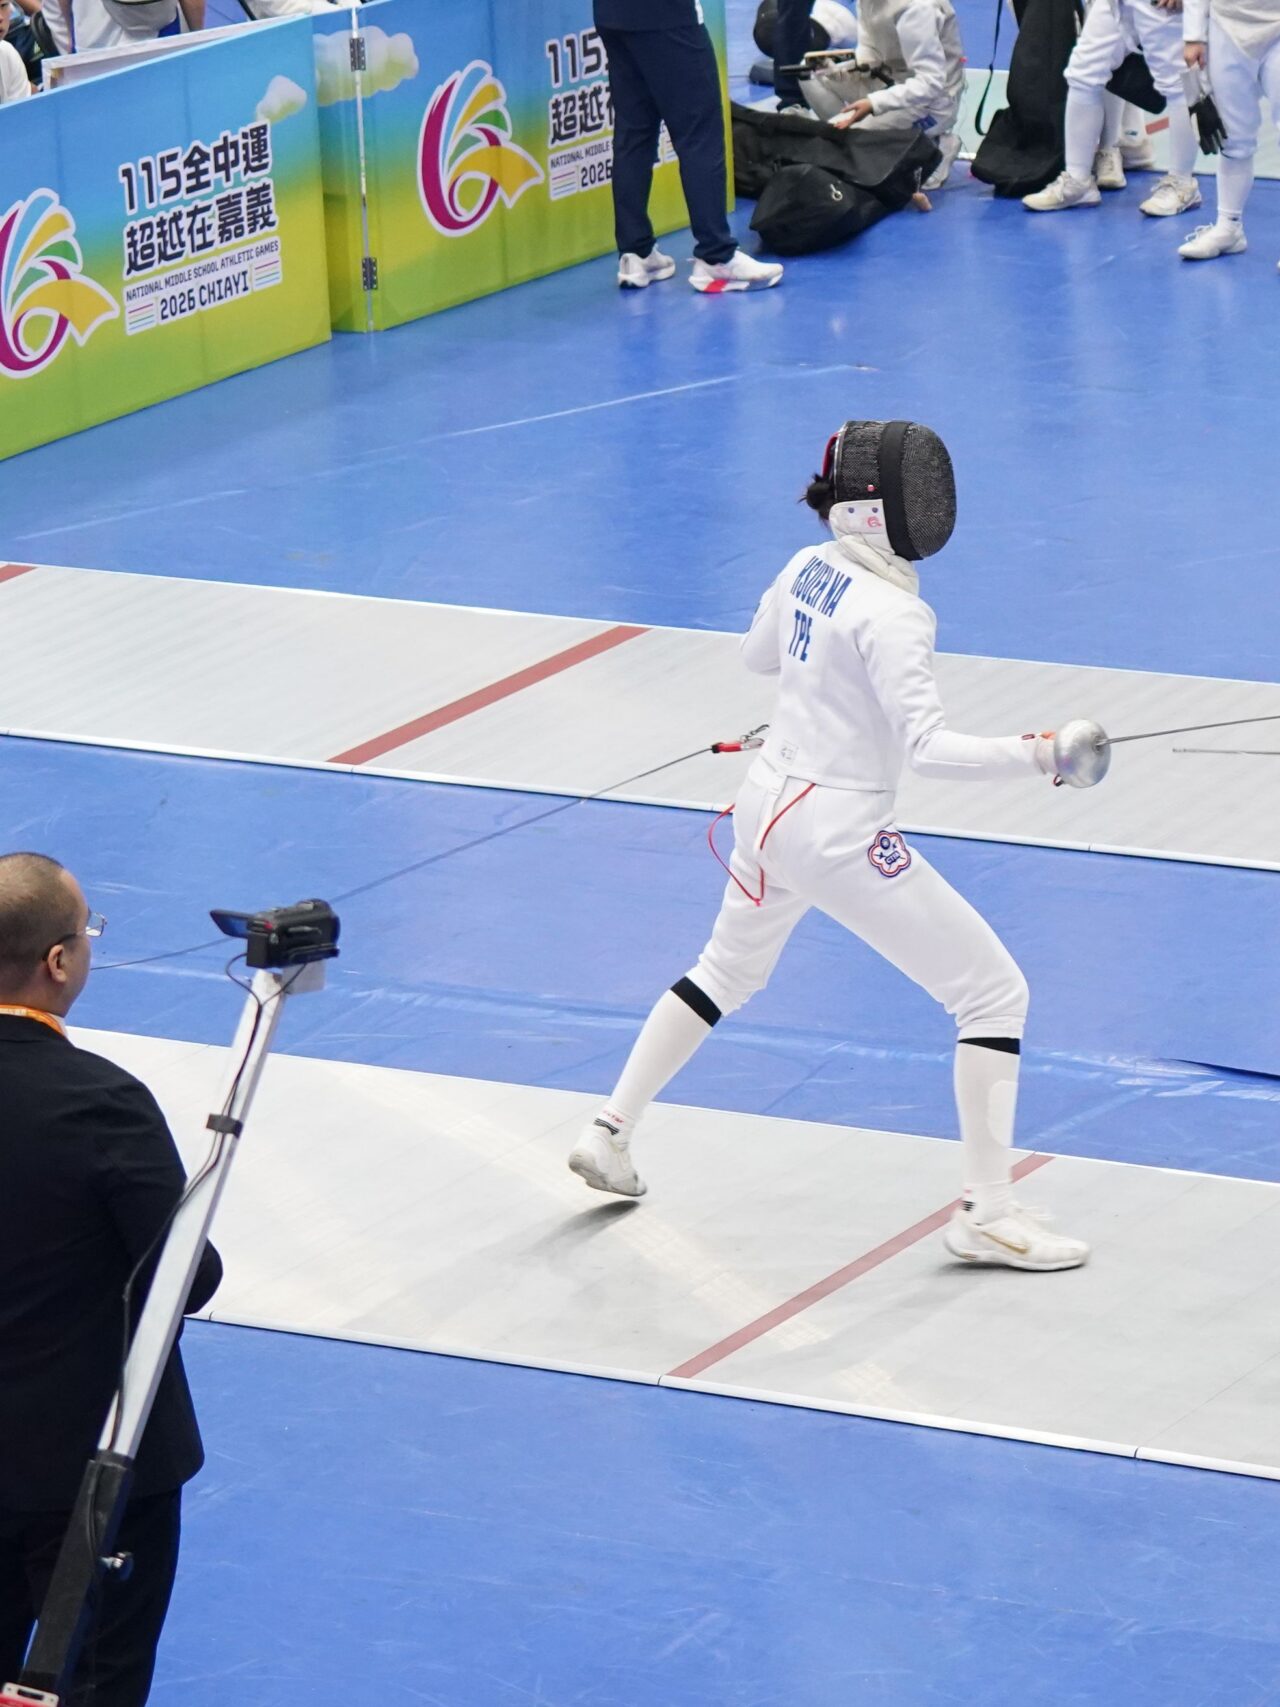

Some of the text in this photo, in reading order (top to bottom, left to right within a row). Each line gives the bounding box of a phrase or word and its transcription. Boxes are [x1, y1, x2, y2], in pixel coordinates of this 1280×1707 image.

[548, 31, 608, 84] 115
[121, 123, 271, 211] 115全中運
[551, 151, 584, 168] NATIONAL
[126, 181, 277, 276] 超越在嘉義
[126, 240, 279, 301] NATIONAL MIDDLE SCHOOL ATHLETIC GAMES
[160, 270, 250, 321] 2026 CHIAYI
[788, 608, 813, 662] TPE
